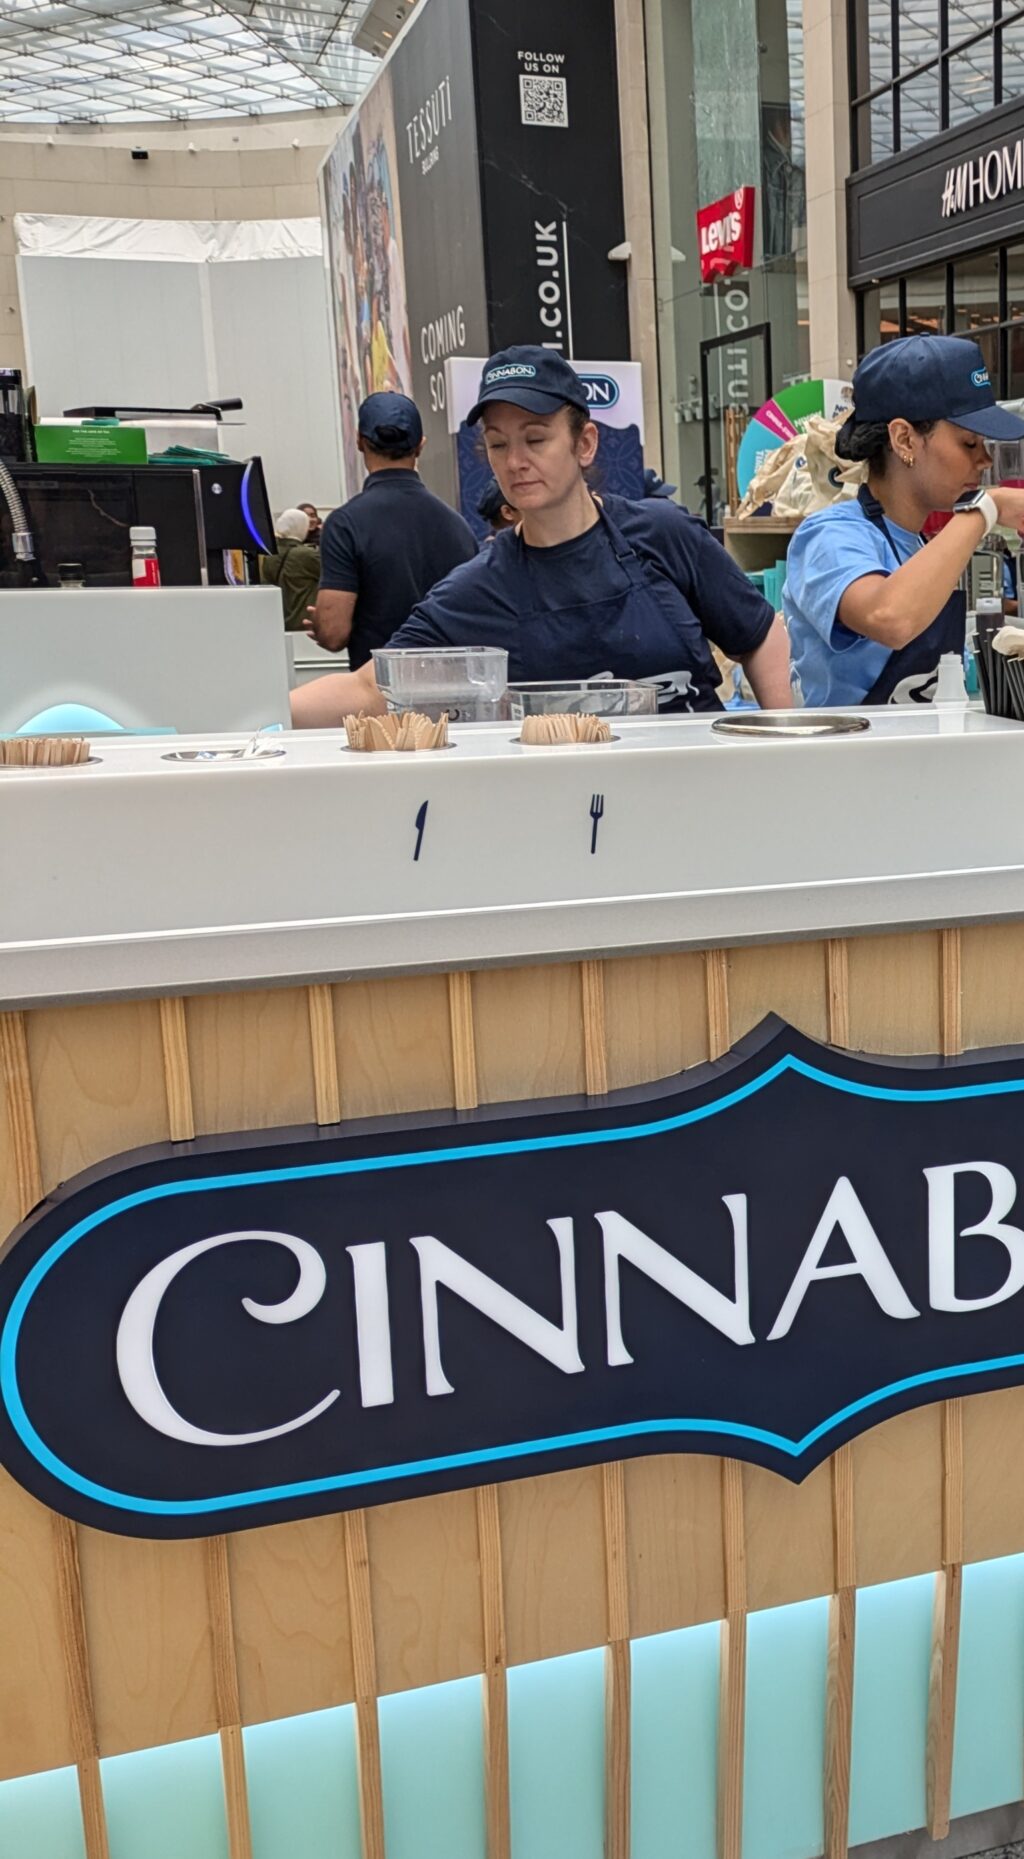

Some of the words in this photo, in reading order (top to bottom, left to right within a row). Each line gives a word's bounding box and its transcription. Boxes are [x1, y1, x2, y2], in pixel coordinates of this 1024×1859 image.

[517, 51, 565, 63] FOLLOW
[524, 62, 539, 72] US
[543, 64, 559, 73] ON
[406, 75, 452, 164] TESSUTI
[941, 161, 968, 218] H&M
[420, 305, 466, 364] COMING
